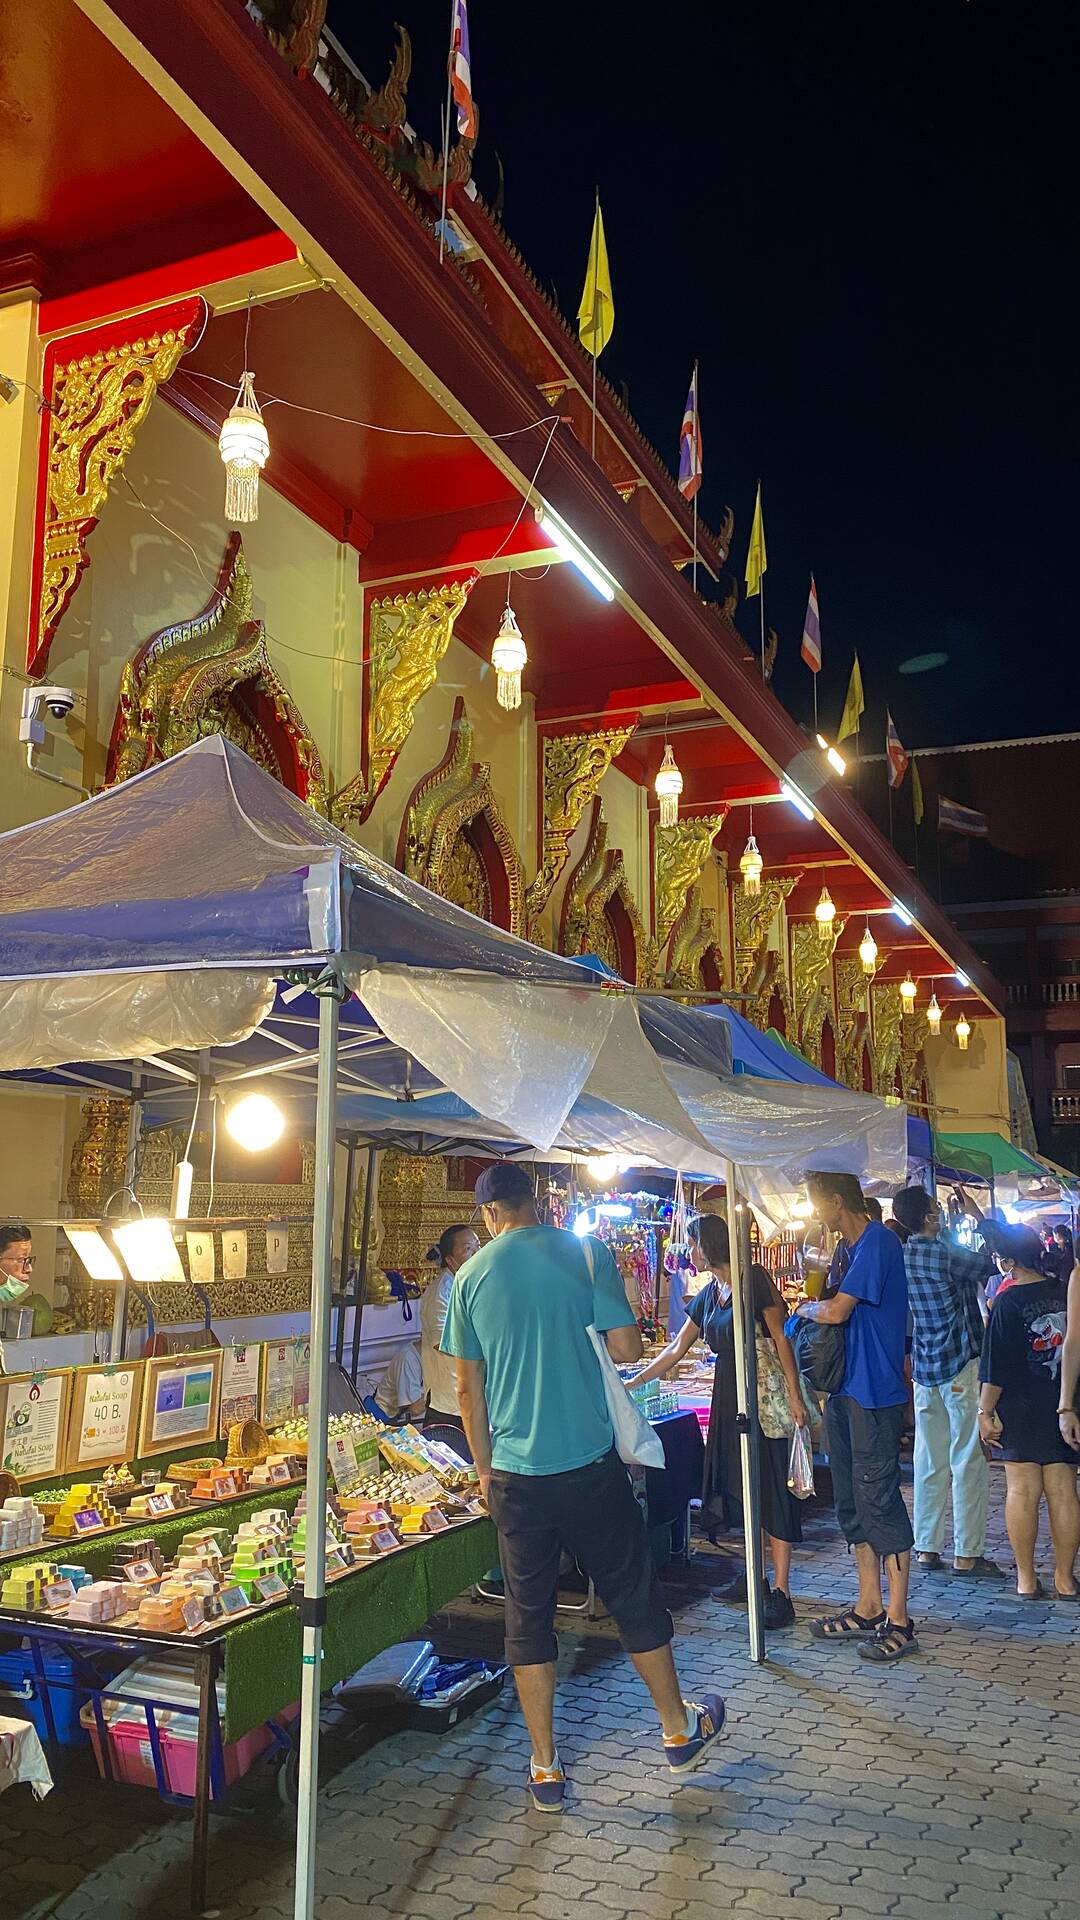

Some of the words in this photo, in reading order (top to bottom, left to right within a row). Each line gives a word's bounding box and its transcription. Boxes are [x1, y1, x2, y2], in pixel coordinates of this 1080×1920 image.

[232, 1242, 238, 1252] a
[274, 1238, 280, 1252] p
[90, 1391, 110, 1402] Natural
[112, 1391, 127, 1401] Soap
[95, 1405, 108, 1421] 40
[15, 1445, 36, 1457] Natural
[38, 1443, 53, 1452] Soap
